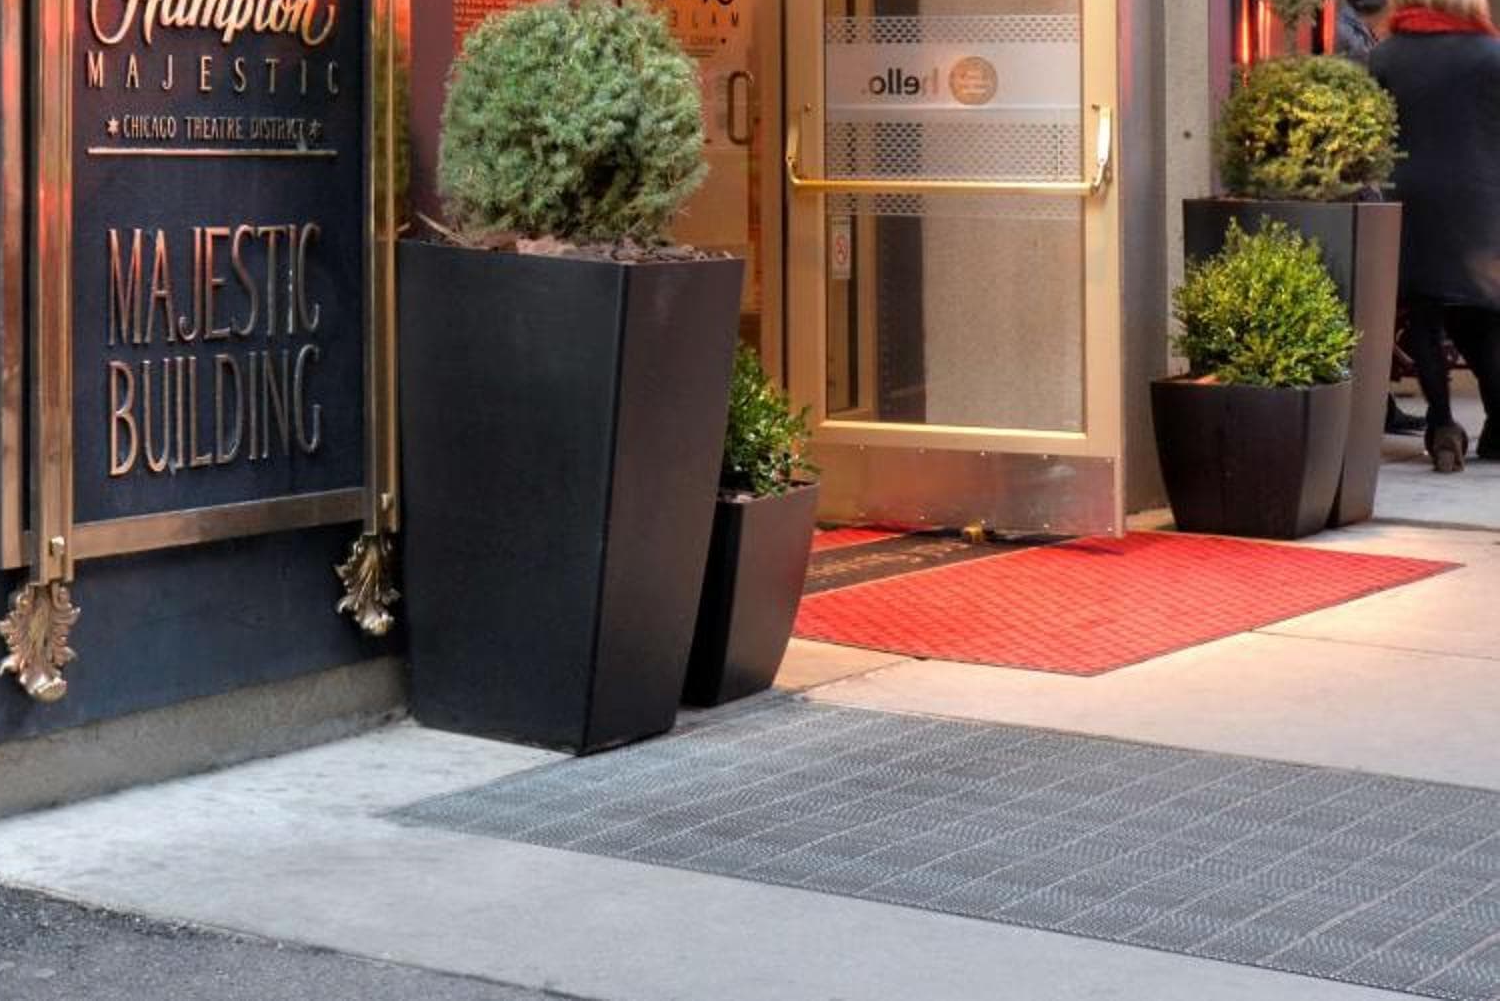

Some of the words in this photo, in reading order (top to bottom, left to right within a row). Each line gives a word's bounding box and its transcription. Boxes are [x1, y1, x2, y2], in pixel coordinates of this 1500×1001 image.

[86, 50, 340, 95] MAJESTIC
[122, 114, 178, 140] CHICAGO
[185, 115, 245, 141] THEATRE
[250, 116, 306, 141] DISTRICT
[107, 222, 322, 347] MAJESTIC
[107, 343, 322, 478] BUILDING
